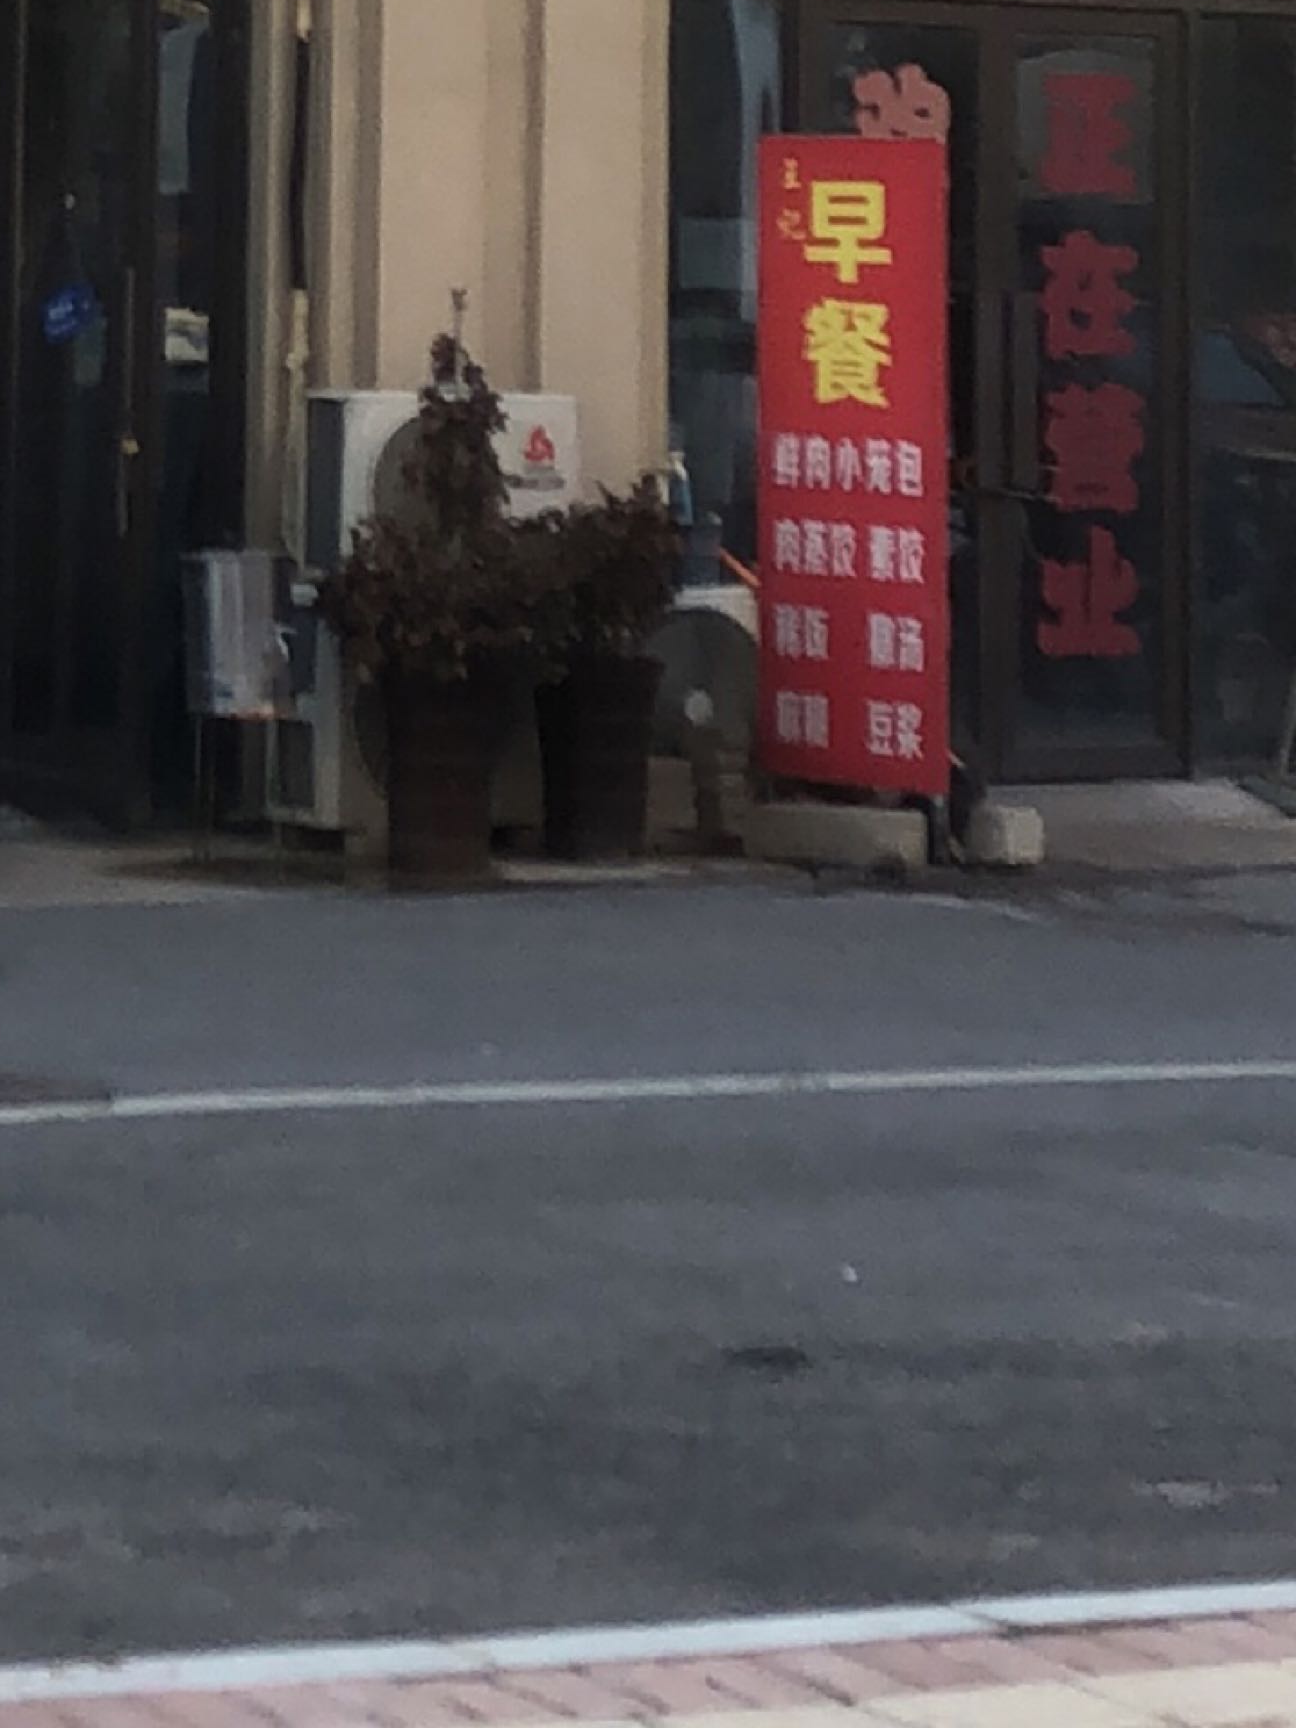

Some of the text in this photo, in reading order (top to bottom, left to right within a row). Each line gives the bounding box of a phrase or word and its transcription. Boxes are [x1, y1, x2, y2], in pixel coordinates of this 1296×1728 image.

[801, 180, 893, 409] 早餐
[1036, 71, 1145, 658] 正在营业
[866, 698, 924, 759] 豆浆
